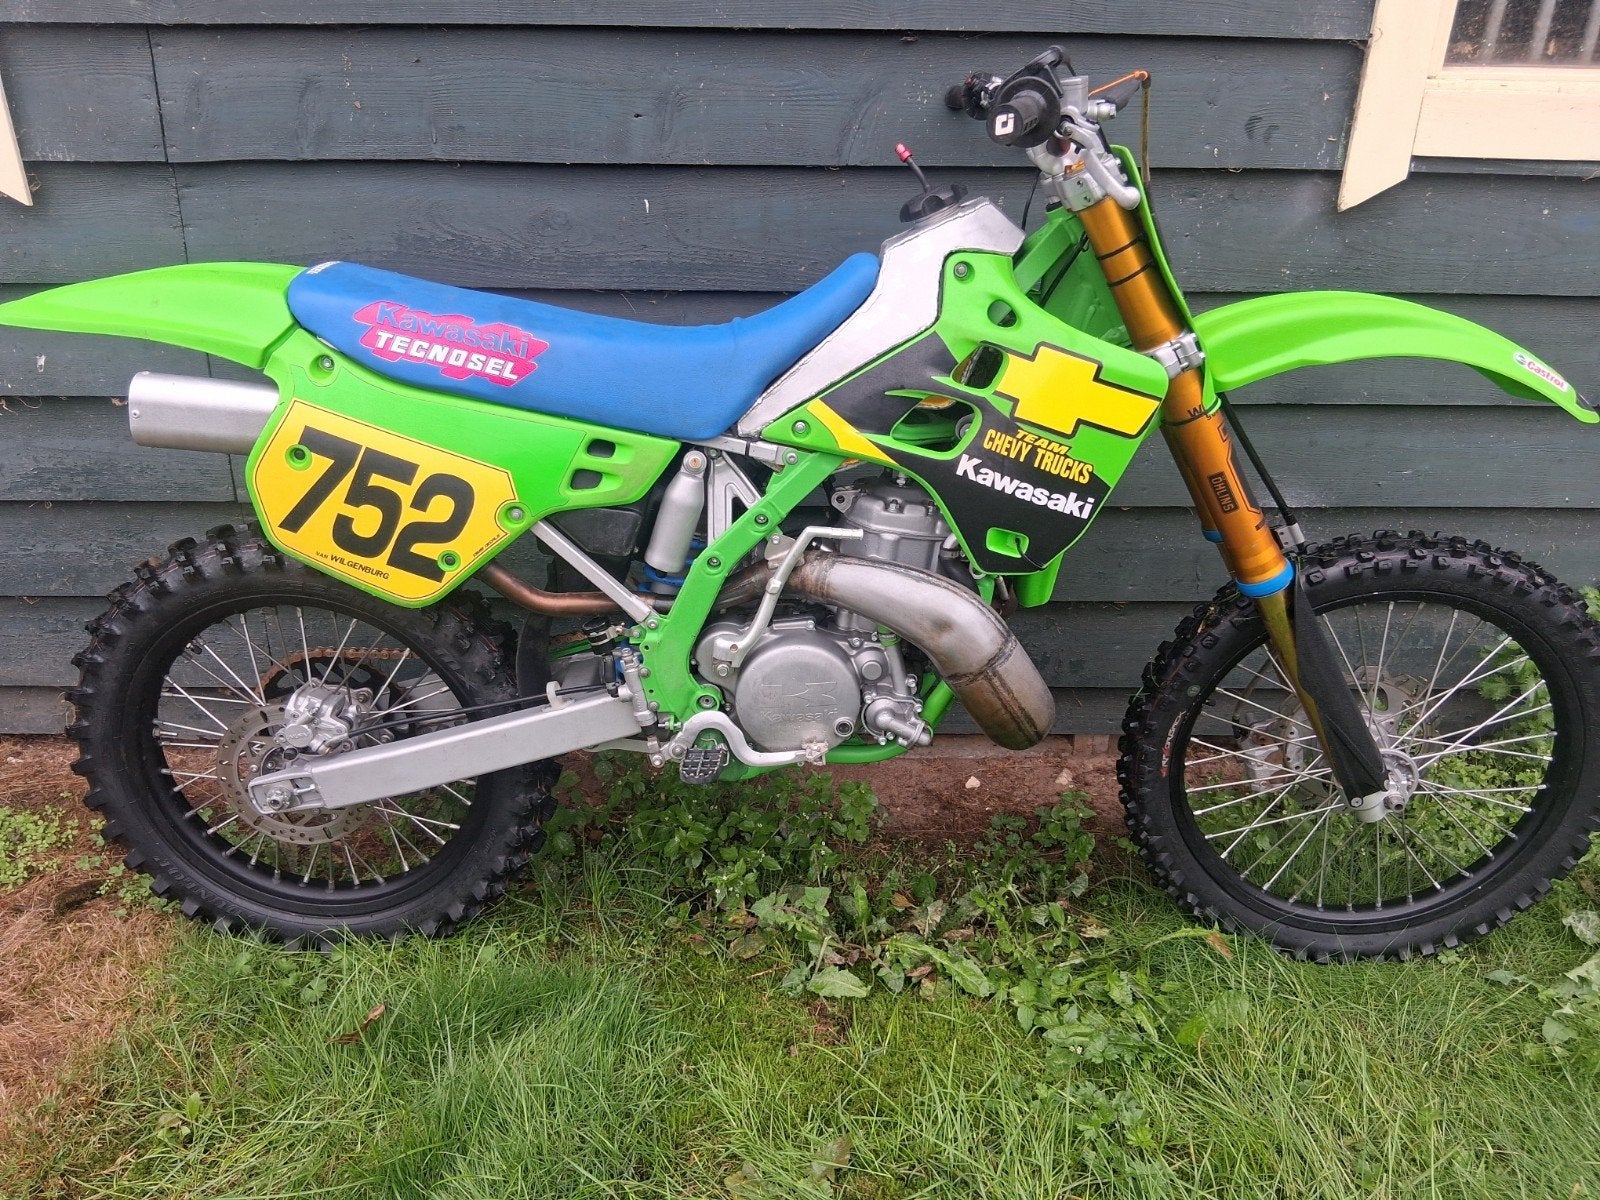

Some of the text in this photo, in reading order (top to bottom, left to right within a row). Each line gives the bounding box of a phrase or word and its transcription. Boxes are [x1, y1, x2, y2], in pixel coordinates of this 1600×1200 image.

[376, 303, 530, 360] Kawasaki
[376, 330, 519, 381] TECNOSEL
[1527, 361, 1565, 388] Castrol
[983, 429, 1094, 485] CHEVY TRUCKS
[1015, 429, 1072, 455] TEAM
[277, 425, 475, 583] 752
[956, 453, 1096, 520] Kawasaki
[316, 551, 390, 580] VAN WILGENBURG
